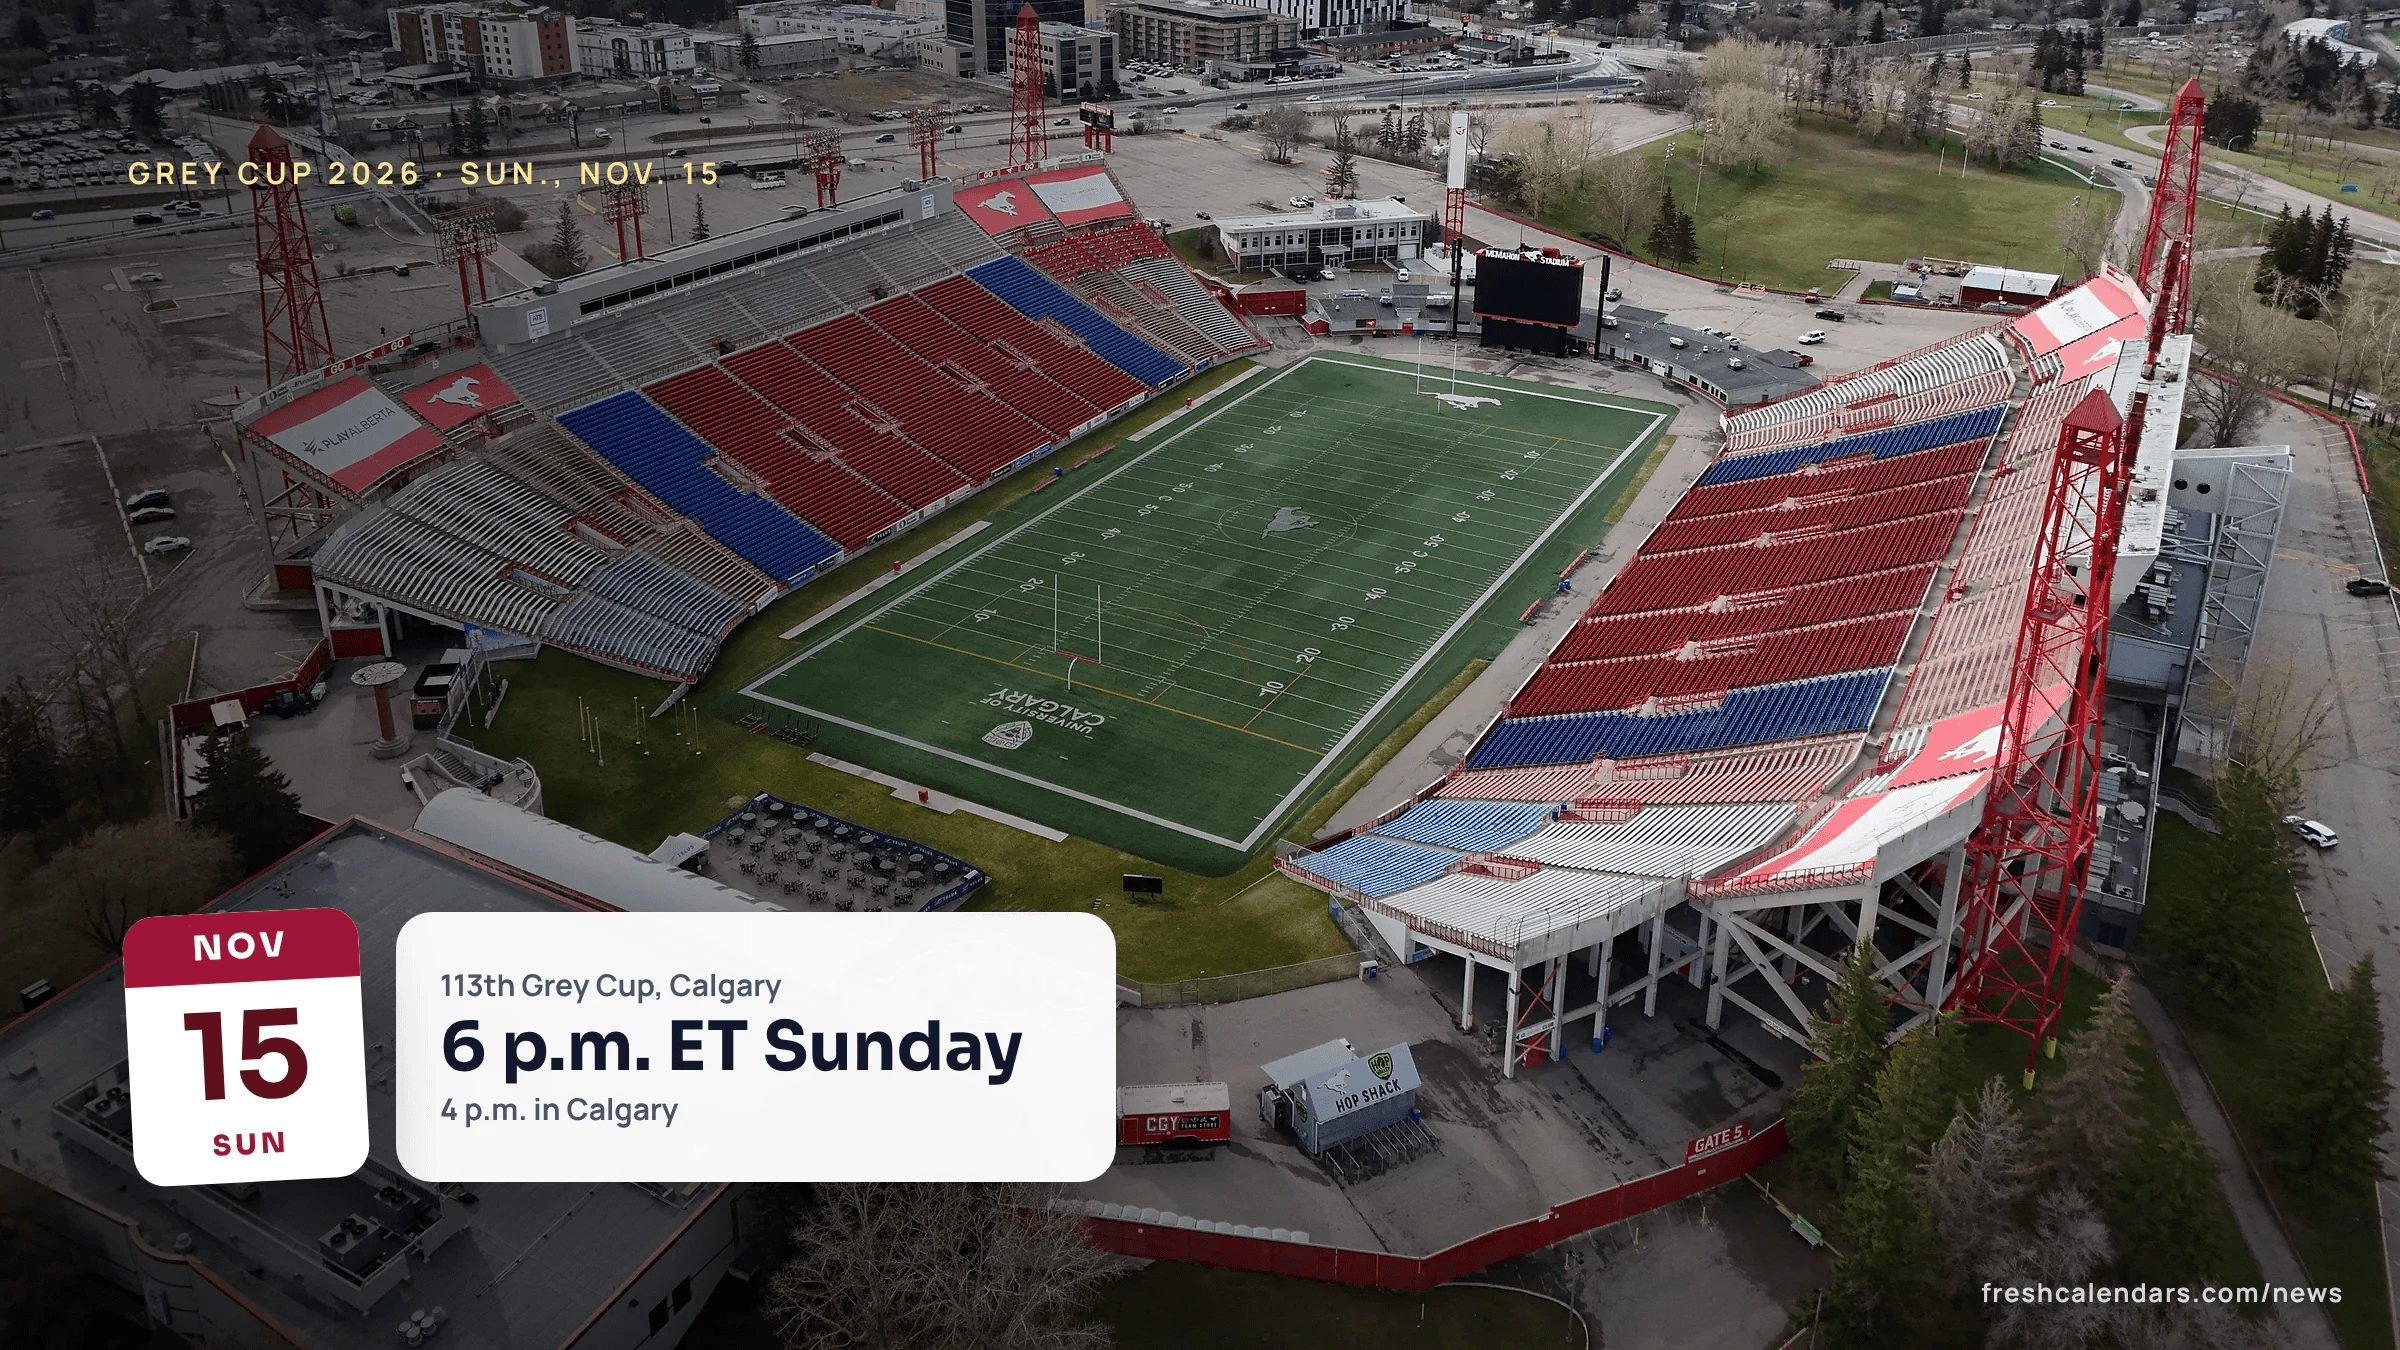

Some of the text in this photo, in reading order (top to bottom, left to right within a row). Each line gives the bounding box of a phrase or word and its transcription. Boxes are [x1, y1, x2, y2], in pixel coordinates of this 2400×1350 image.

[1540, 256, 1569, 267] STADIUM
[390, 339, 404, 351] GO
[330, 362, 345, 374] GO
[322, 406, 396, 449] PLAYALBERTA
[1500, 471, 1519, 480] 20
[1172, 482, 1192, 492] 50
[1476, 490, 1495, 501] 30
[1138, 504, 1159, 515] 50
[1452, 512, 1471, 523] 40
[877, 527, 891, 540] TELUS
[1101, 528, 1121, 538] 40
[1423, 535, 1445, 548] 50
[1062, 551, 1085, 563] 30
[1413, 550, 1428, 558] C
[1395, 561, 1417, 573] 50
[1020, 578, 1043, 590] 20
[1366, 587, 1387, 600] 40
[975, 609, 997, 620] 10
[1332, 616, 1355, 630] 30
[1296, 647, 1321, 663] 20
[1261, 681, 1284, 694] 10
[988, 688, 1105, 726] CALGARY
[980, 698, 1093, 734] UNIVERSITY OF
[677, 844, 695, 858] TELUS
[1370, 1055, 1389, 1071] HOP
[1335, 1078, 1402, 1113] HOP SHACK
[1146, 1116, 1179, 1132] CGY
[1694, 1128, 1731, 1153] GATE
[1733, 1124, 1743, 1140] 5
